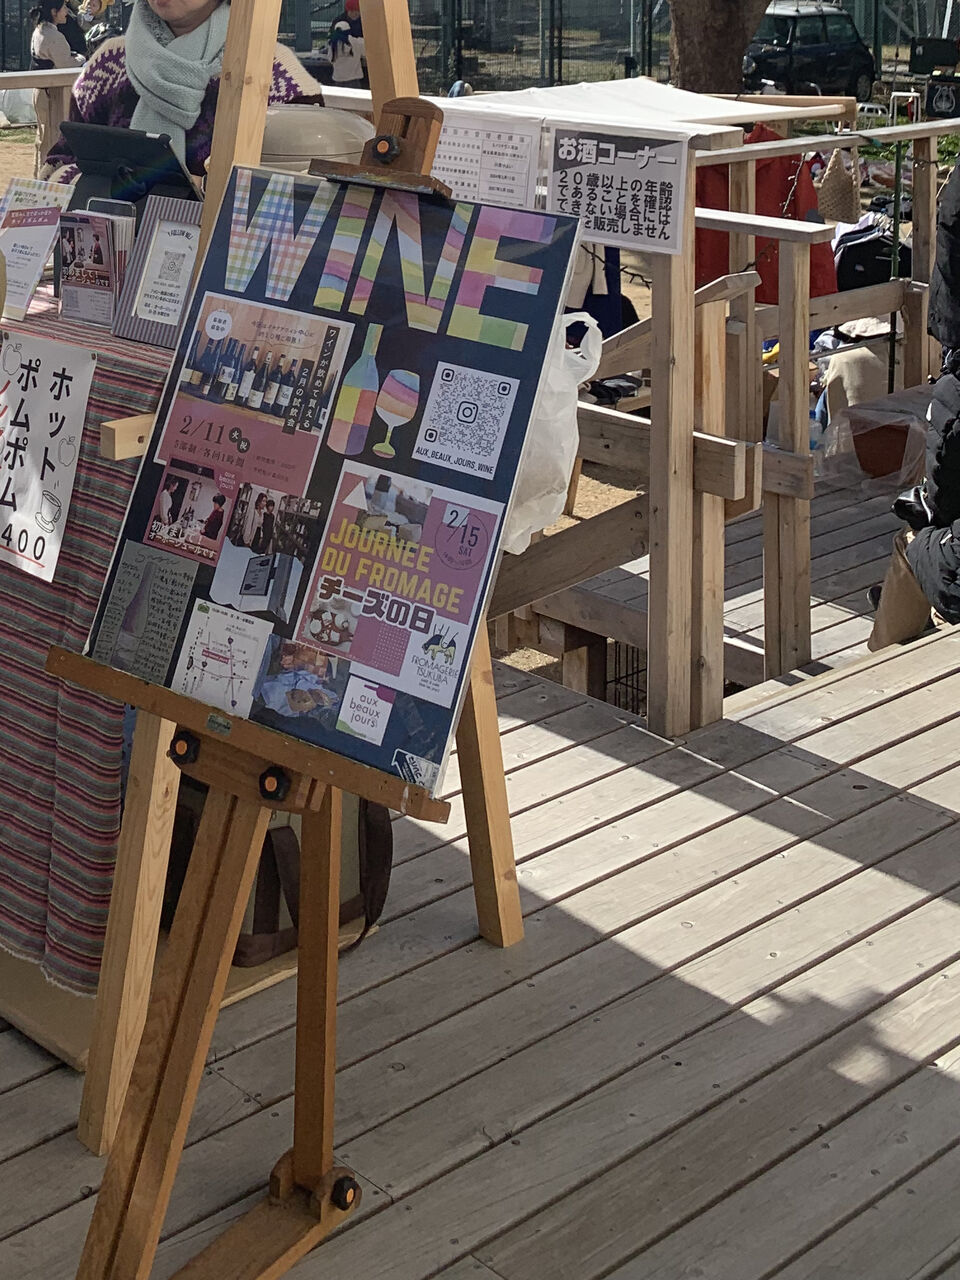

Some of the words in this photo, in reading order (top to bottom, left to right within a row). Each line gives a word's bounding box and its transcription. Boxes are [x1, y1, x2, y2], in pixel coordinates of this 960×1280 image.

[558, 136, 677, 169] お酒コーナー
[225, 169, 557, 351] WINE
[286, 368, 309, 428] 2月の試飲会
[303, 329, 337, 428] ワインが飲めて買える
[40, 367, 74, 481] ホット
[179, 415, 226, 445] 2/11
[415, 446, 495, 474] AUX_BEAUX_JOURS_WINE
[329, 518, 436, 573] JOURNEE
[445, 509, 481, 549] 2/15
[321, 547, 351, 576] DU
[354, 556, 465, 614] FROMAGE
[318, 576, 436, 634] チーズの日
[349, 697, 381, 719] beaux
[350, 712, 376, 728] jours
[359, 693, 379, 707] aux
